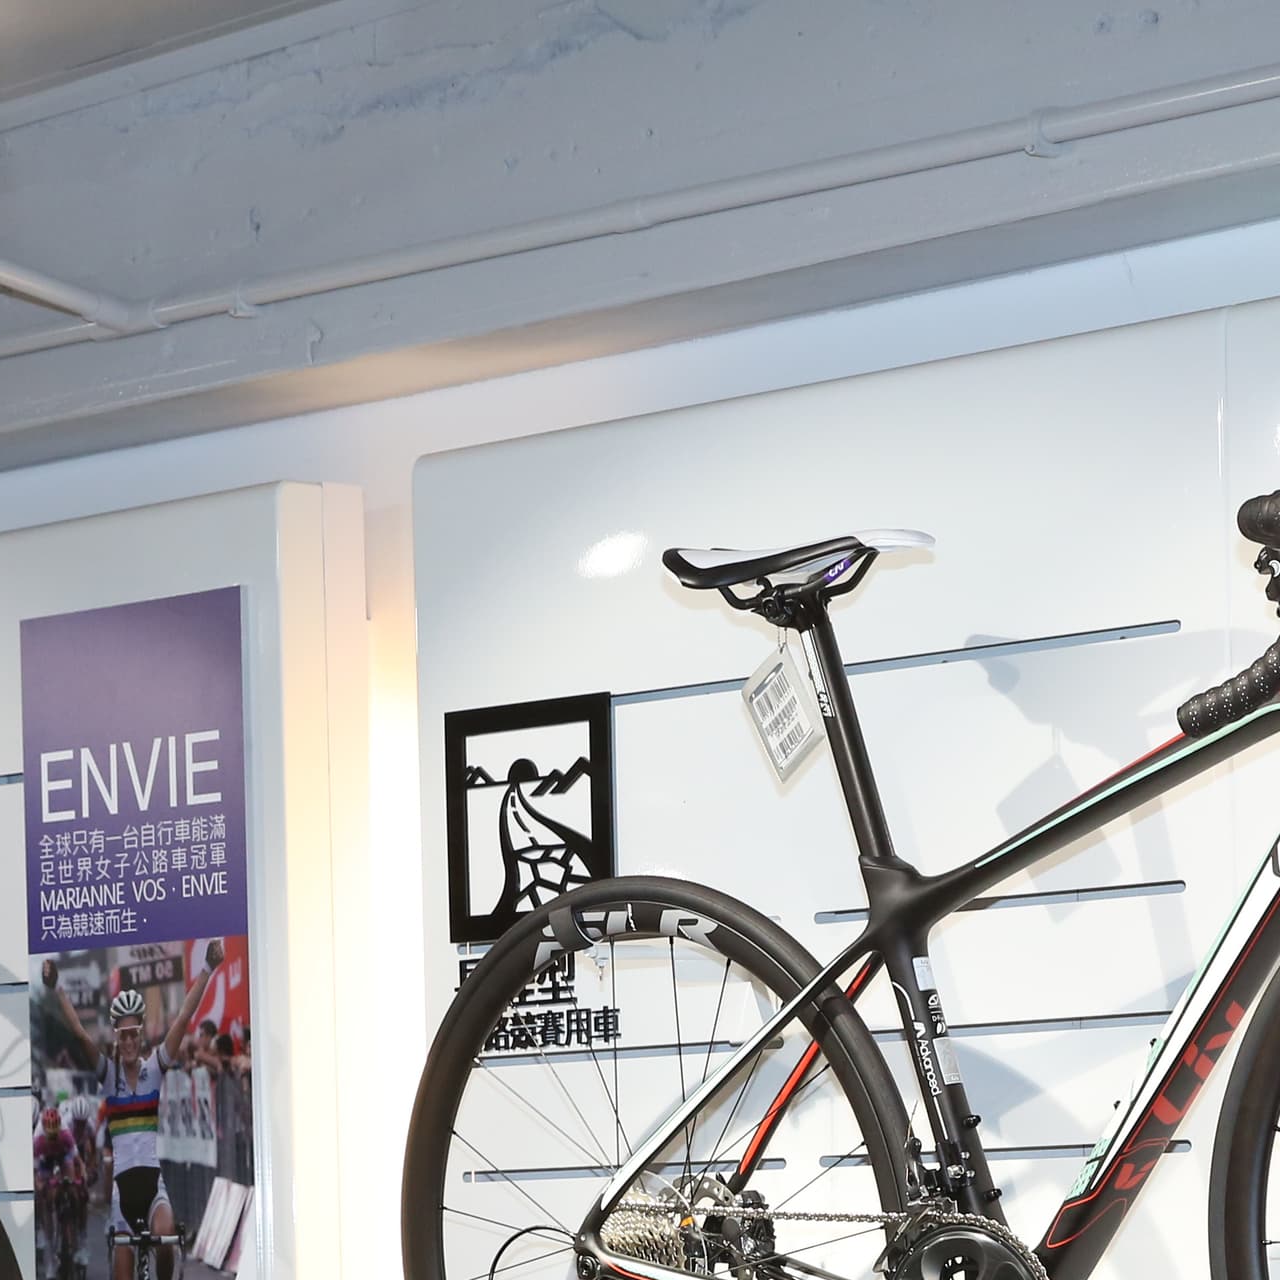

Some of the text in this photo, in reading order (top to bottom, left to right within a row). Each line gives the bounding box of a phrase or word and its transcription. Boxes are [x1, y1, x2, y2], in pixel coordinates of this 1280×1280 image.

[40, 729, 222, 824] ENVIE
[39, 813, 227, 860] 全球只有一台自行車能滿
[40, 842, 228, 887] 足世界女子公路車冠軍
[40, 882, 126, 913] MARIANNE
[182, 871, 228, 898] ENVIE
[917, 1037, 942, 1097] Advanced
